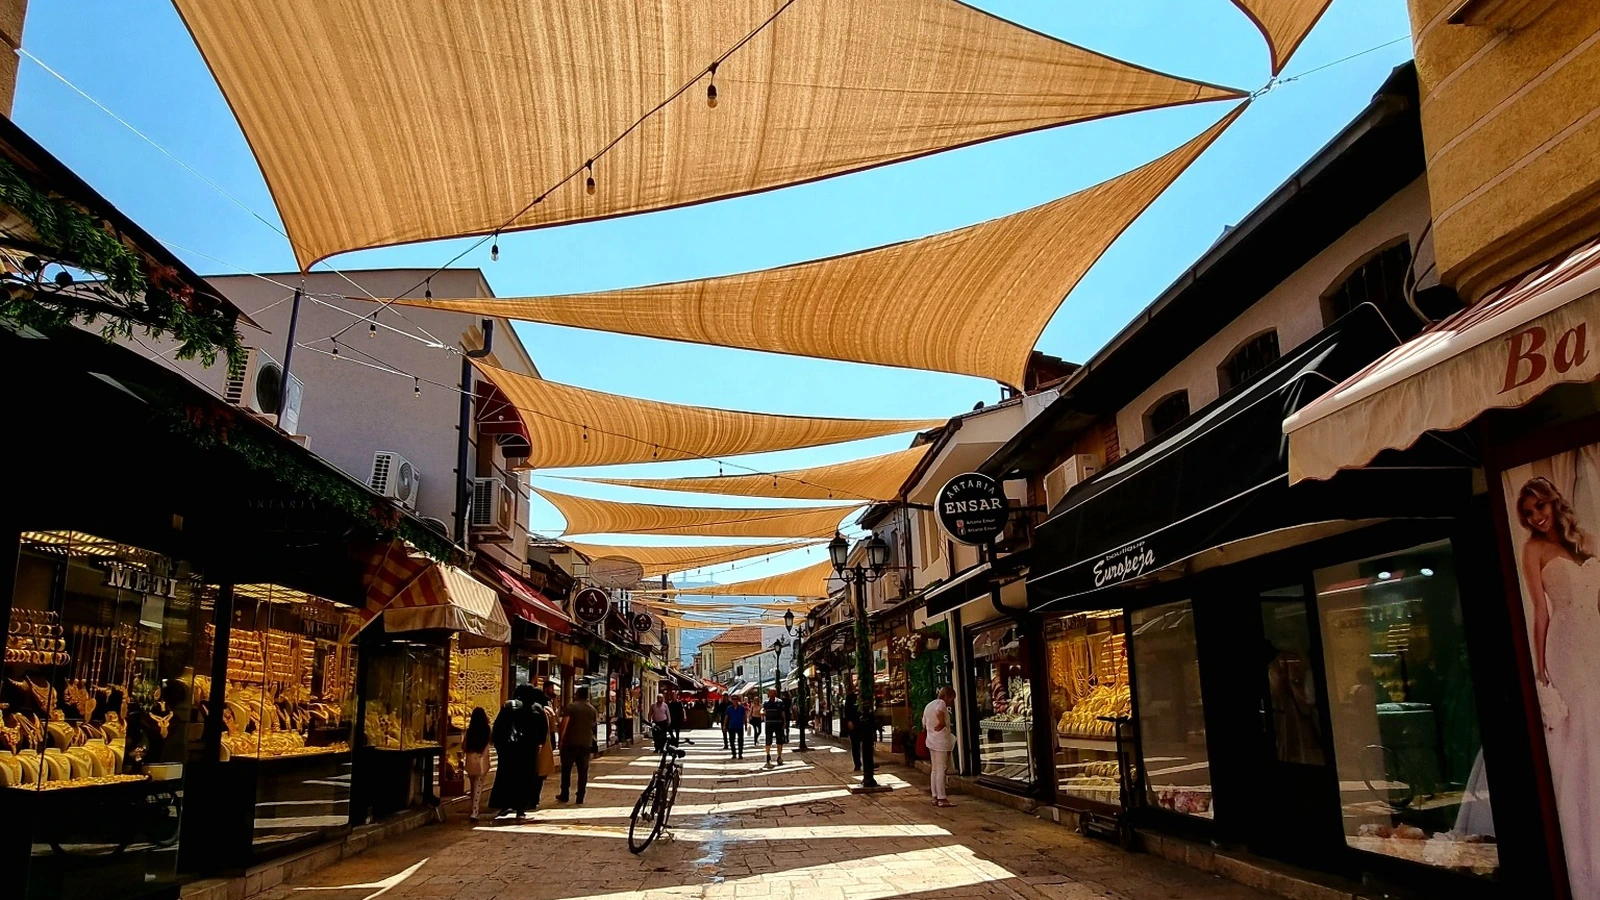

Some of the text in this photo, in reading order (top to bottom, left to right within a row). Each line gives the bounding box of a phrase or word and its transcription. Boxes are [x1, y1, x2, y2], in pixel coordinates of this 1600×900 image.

[1497, 322, 1590, 395] Ba
[944, 497, 1003, 515] ENSAR
[946, 480, 995, 499] ARTARIA
[108, 565, 178, 599] METI
[1093, 546, 1156, 587] Europeja
